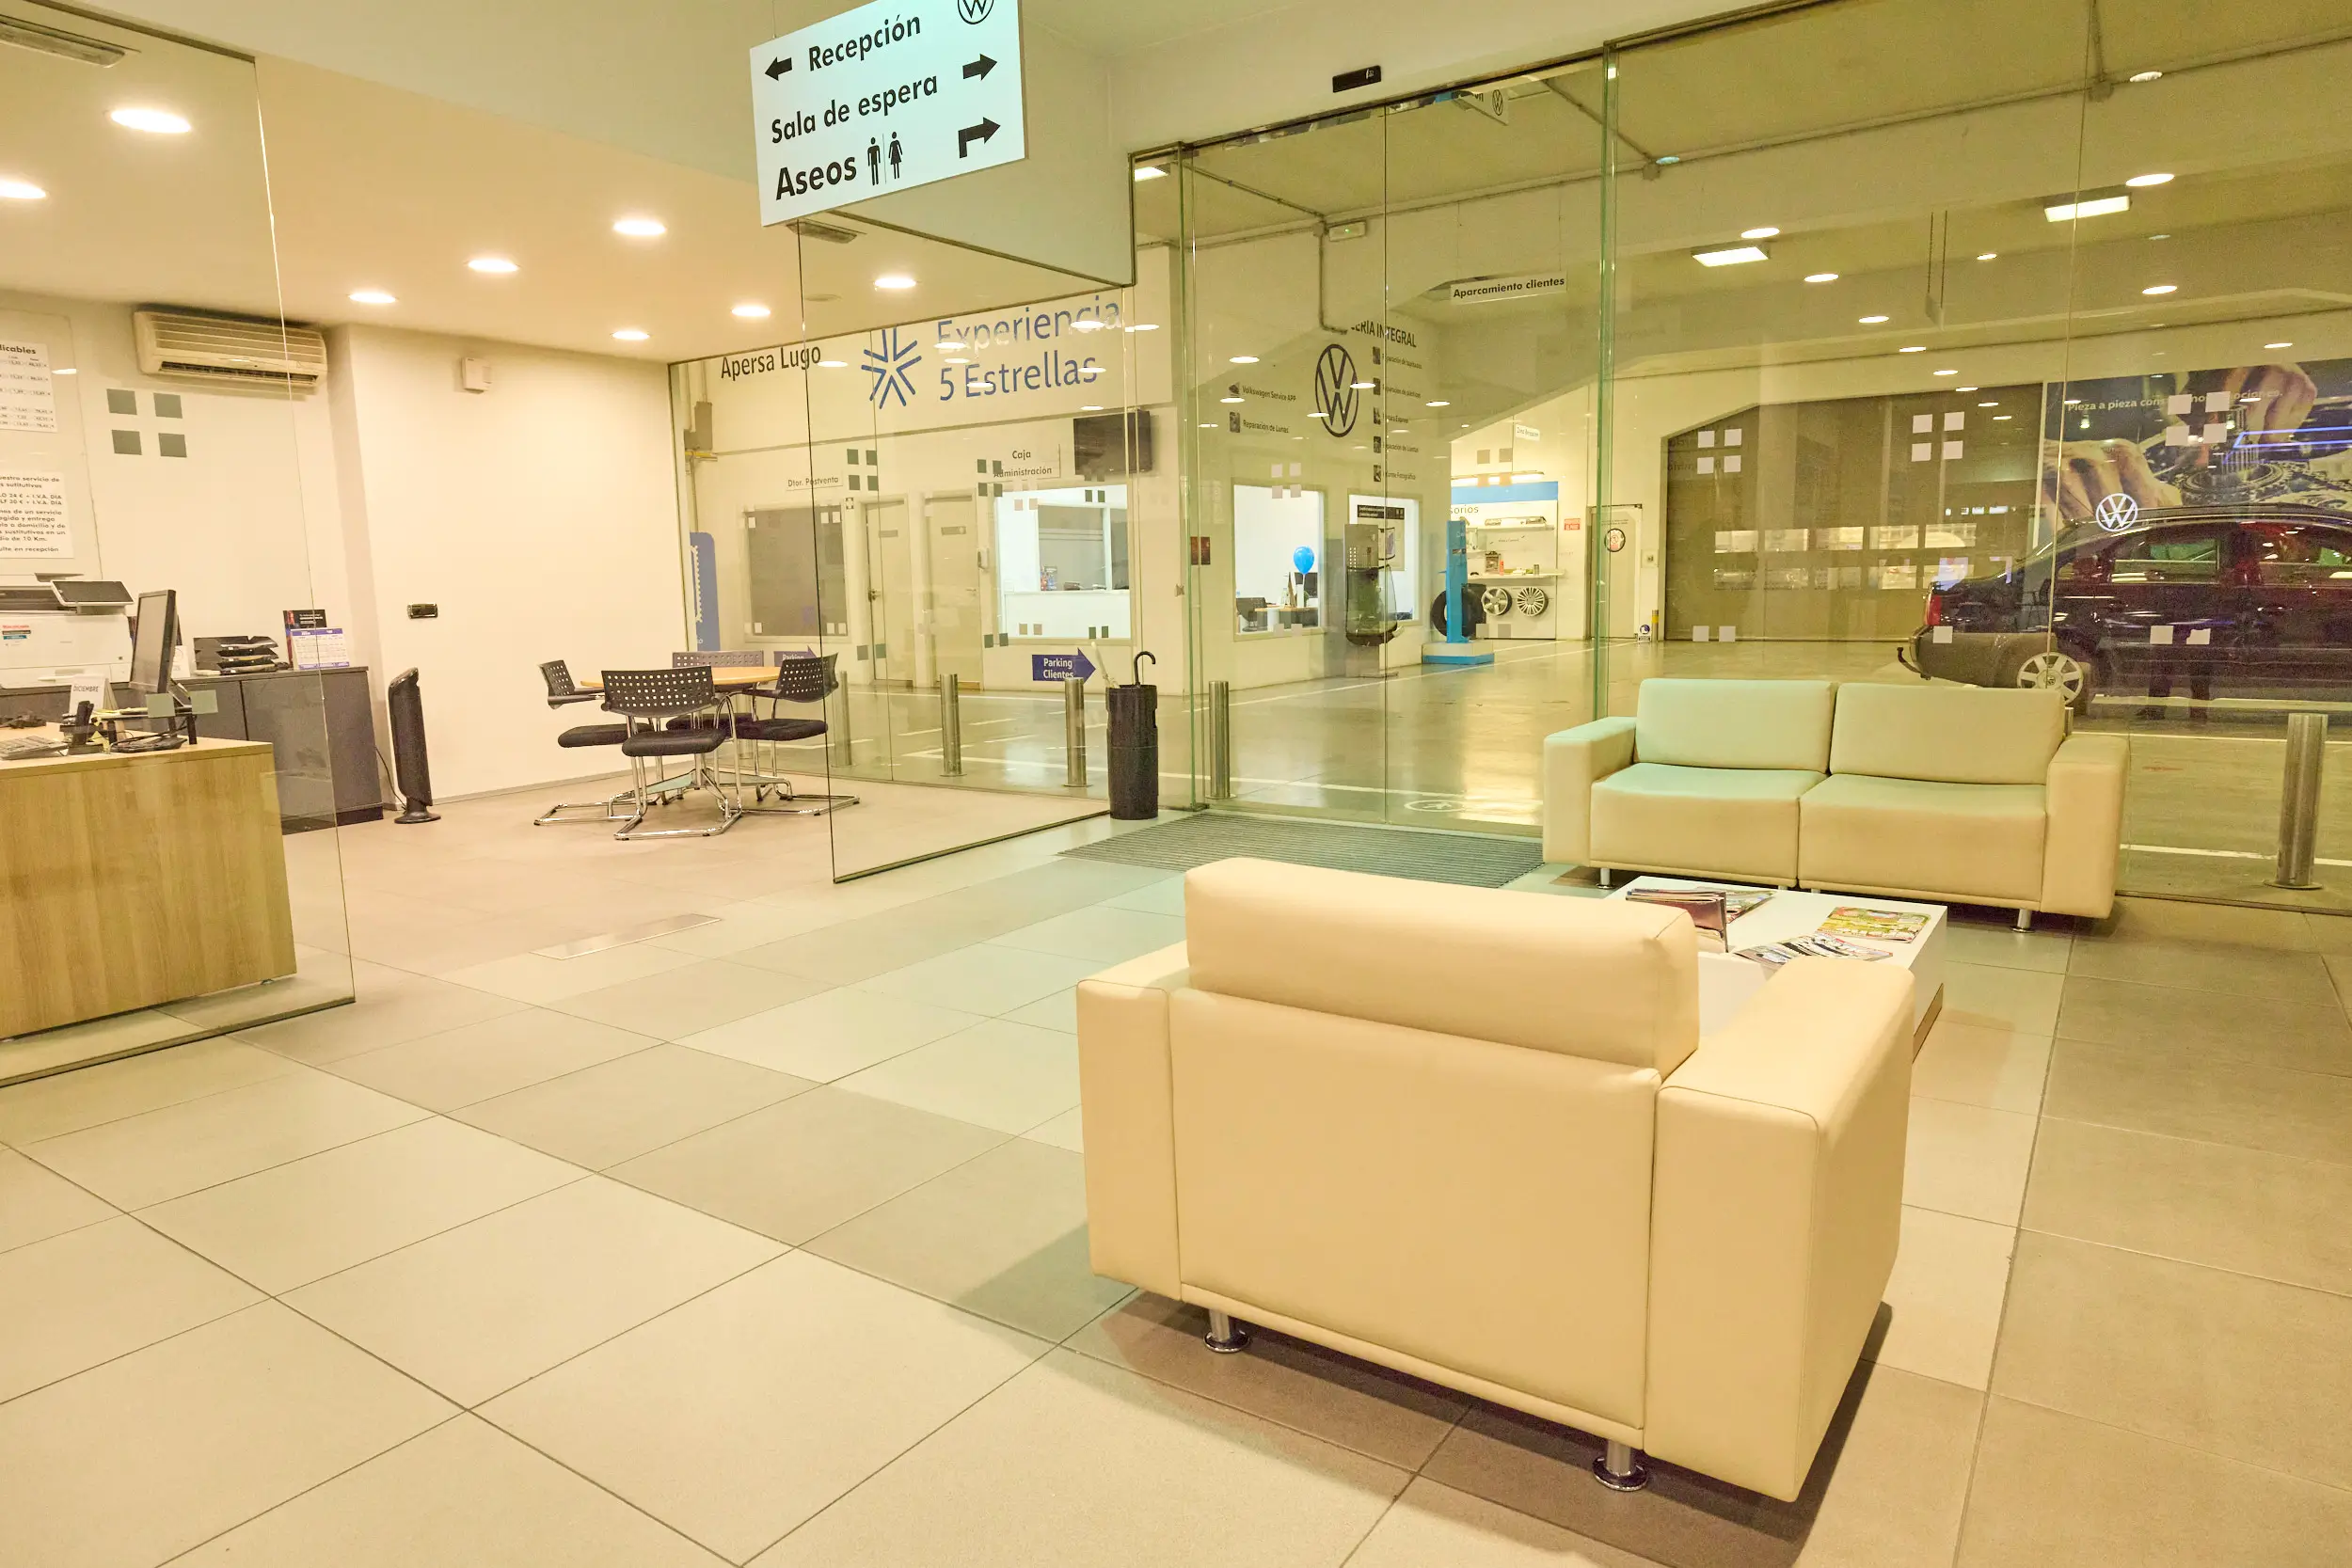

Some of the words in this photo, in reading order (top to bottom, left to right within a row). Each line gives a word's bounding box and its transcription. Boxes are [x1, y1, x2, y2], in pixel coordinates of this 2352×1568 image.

[808, 14, 921, 71] Recepción
[771, 110, 817, 144] Sala
[823, 99, 850, 127] de
[857, 74, 938, 117] espera
[775, 155, 858, 201] Aseos
[1453, 283, 1523, 299] Aparcamiento
[1525, 277, 1565, 290] clientes
[936, 294, 1123, 358] Experiencia
[720, 354, 775, 382] Apersa
[779, 345, 822, 371] Lugo
[939, 367, 955, 402] 5
[964, 349, 1099, 398] Estrellas
[2067, 403, 2097, 412] Pieza
[2098, 402, 2106, 410] a
[2107, 399, 2137, 411] pieza
[1011, 450, 1032, 460] Caja
[804, 476, 839, 486] Postventa
[993, 466, 1053, 479] Administración
[1042, 657, 1073, 670] Parking
[1042, 669, 1074, 679] Clientes
[72, 685, 100, 693] DICIEMBRE
